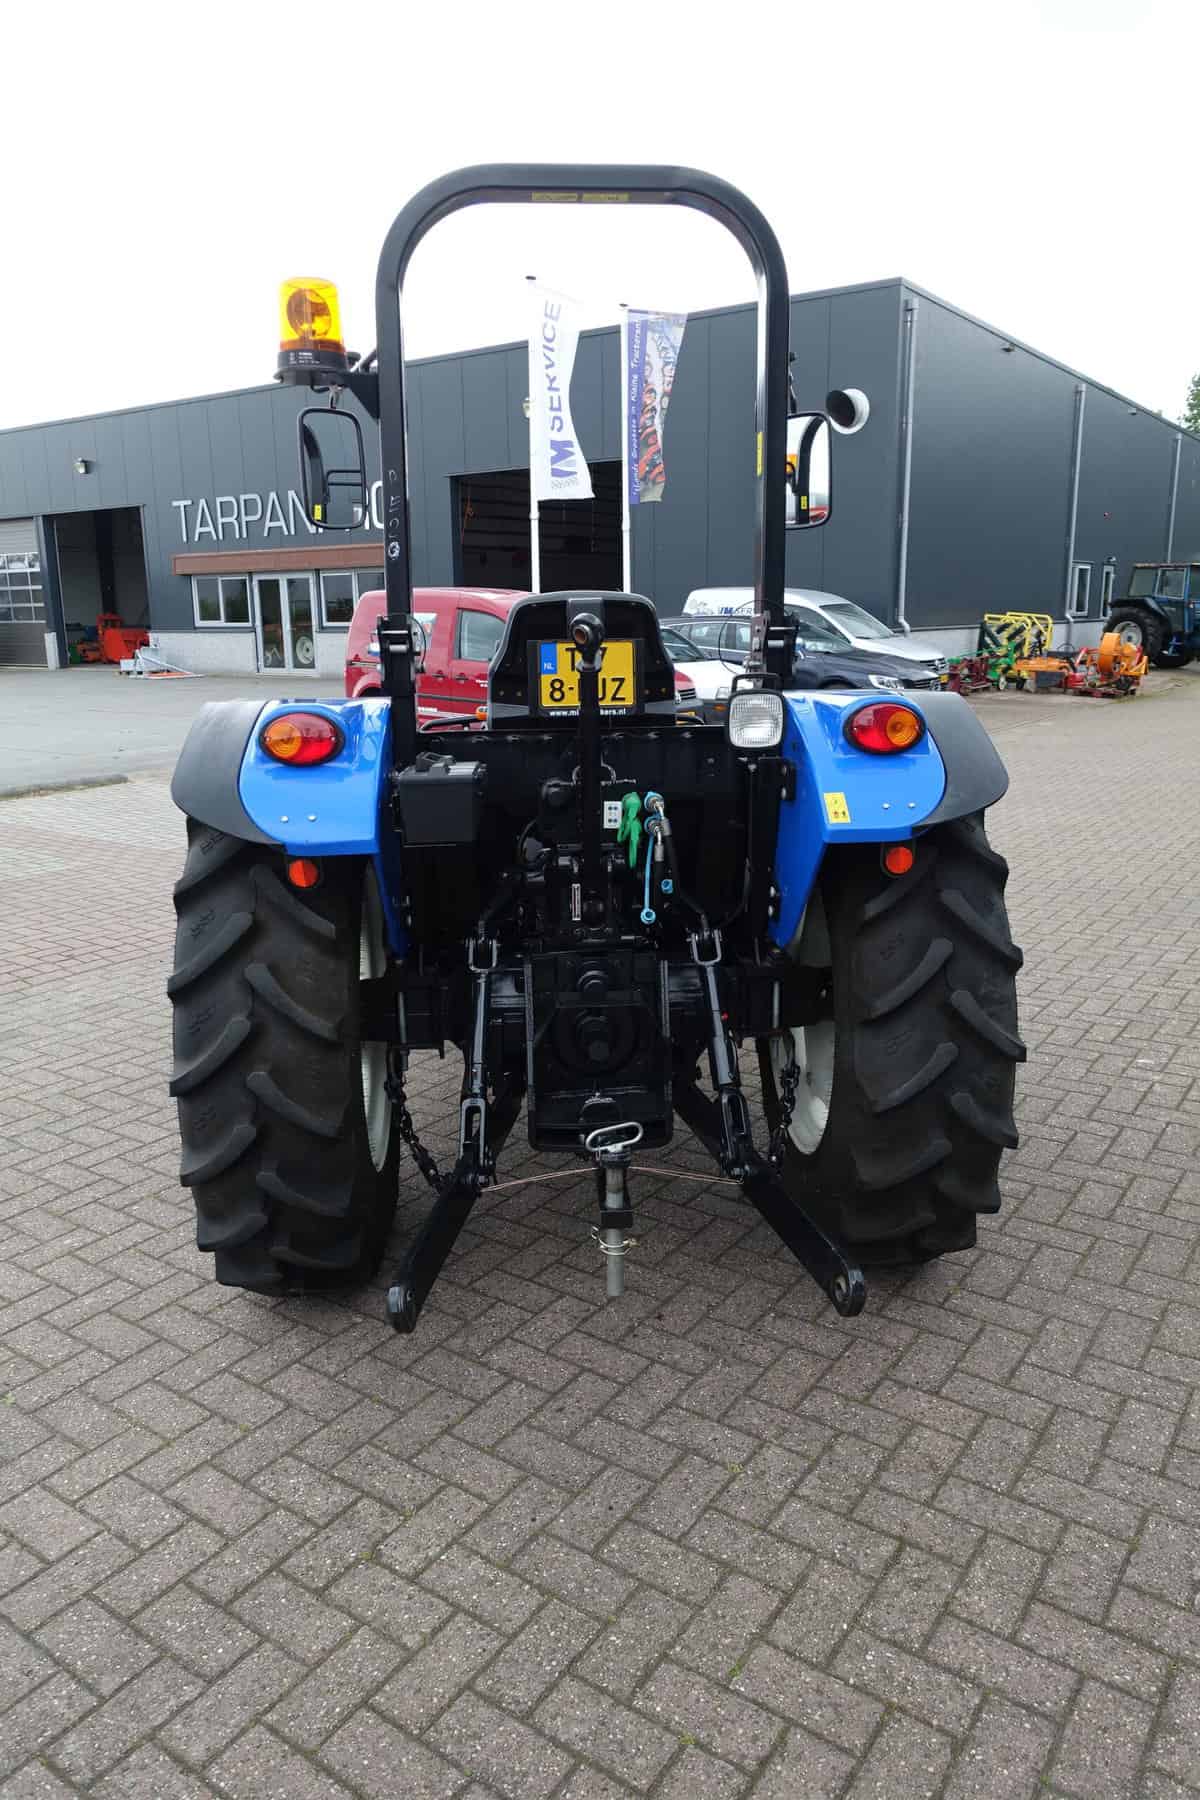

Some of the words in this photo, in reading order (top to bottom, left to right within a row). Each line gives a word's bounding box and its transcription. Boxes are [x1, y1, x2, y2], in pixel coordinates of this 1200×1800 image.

[543, 299, 564, 433] SERVICE
[171, 489, 323, 542] TARPAN
[543, 661, 555, 671] NL
[565, 646, 608, 672] T7
